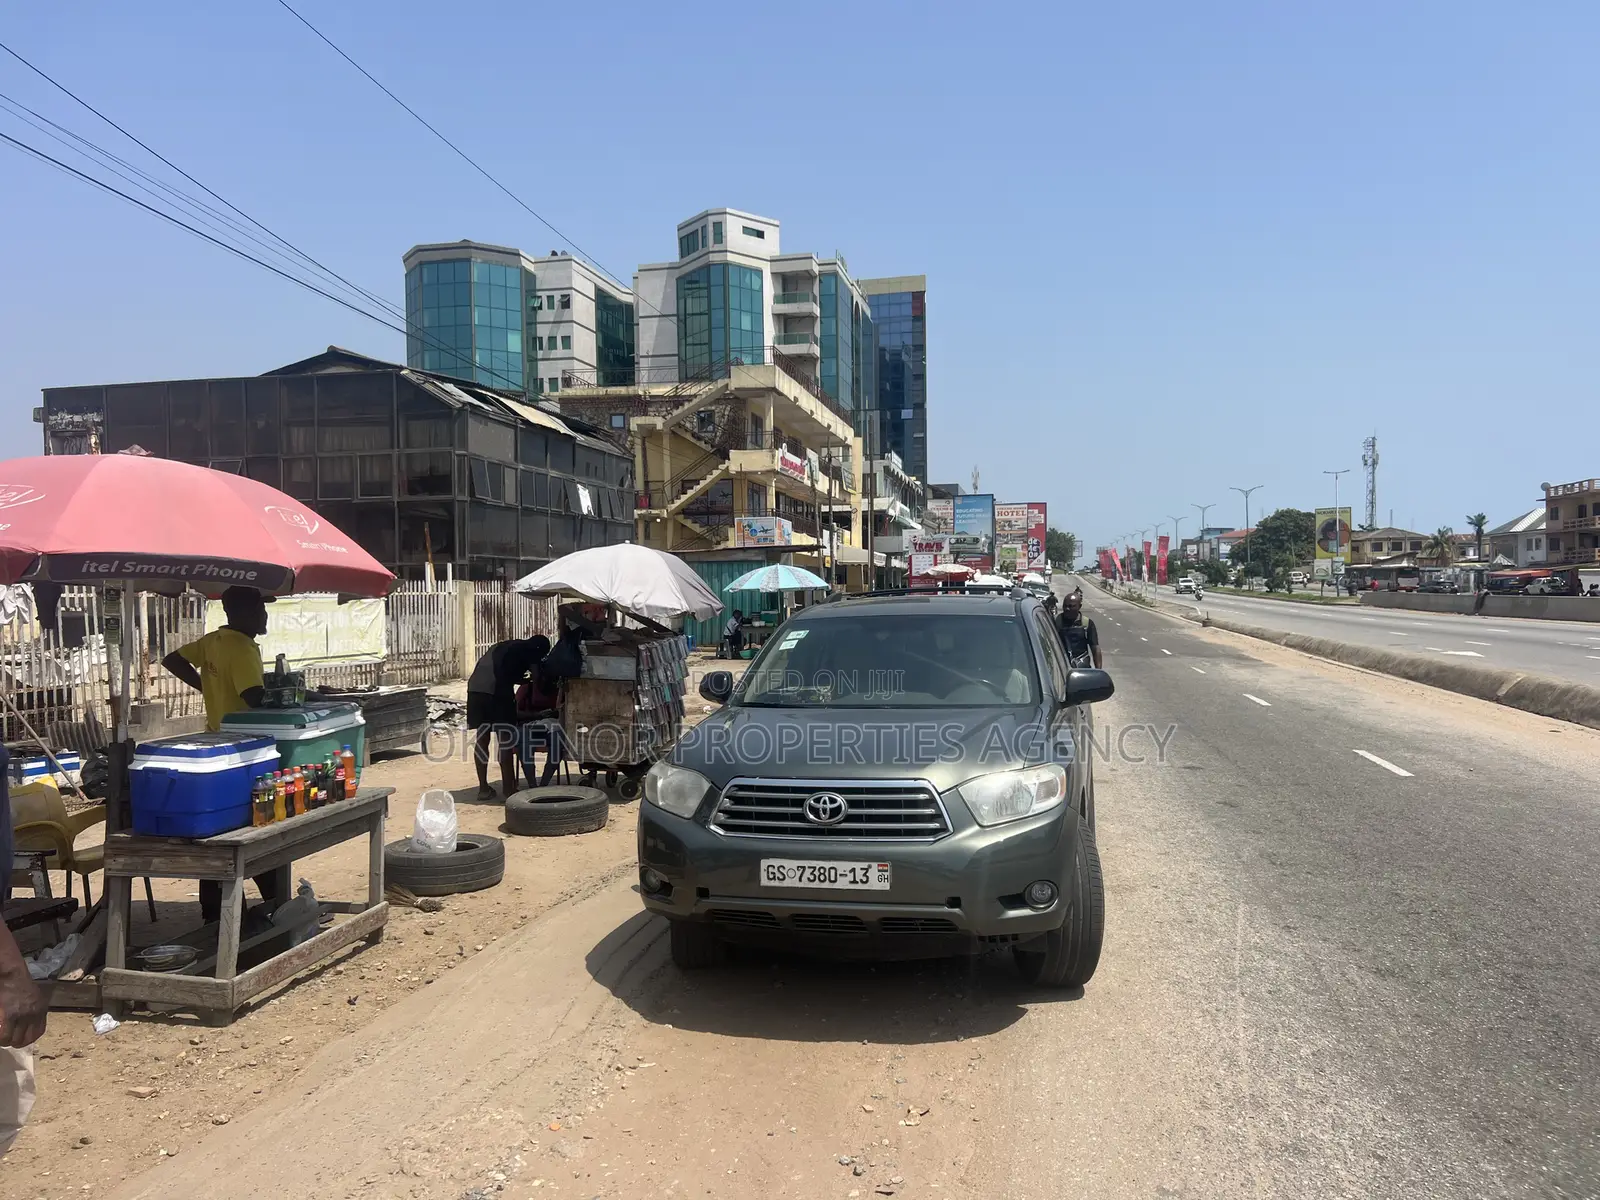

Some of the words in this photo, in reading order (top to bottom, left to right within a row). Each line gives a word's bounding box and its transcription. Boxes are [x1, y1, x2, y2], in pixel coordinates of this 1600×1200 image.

[913, 541, 945, 551] TRAVEL
[81, 560, 120, 573] itel
[122, 561, 190, 576] Smart
[192, 564, 258, 581] Phone
[766, 864, 787, 882] GS
[796, 865, 870, 884] 7380-13
[877, 874, 889, 883] GH
